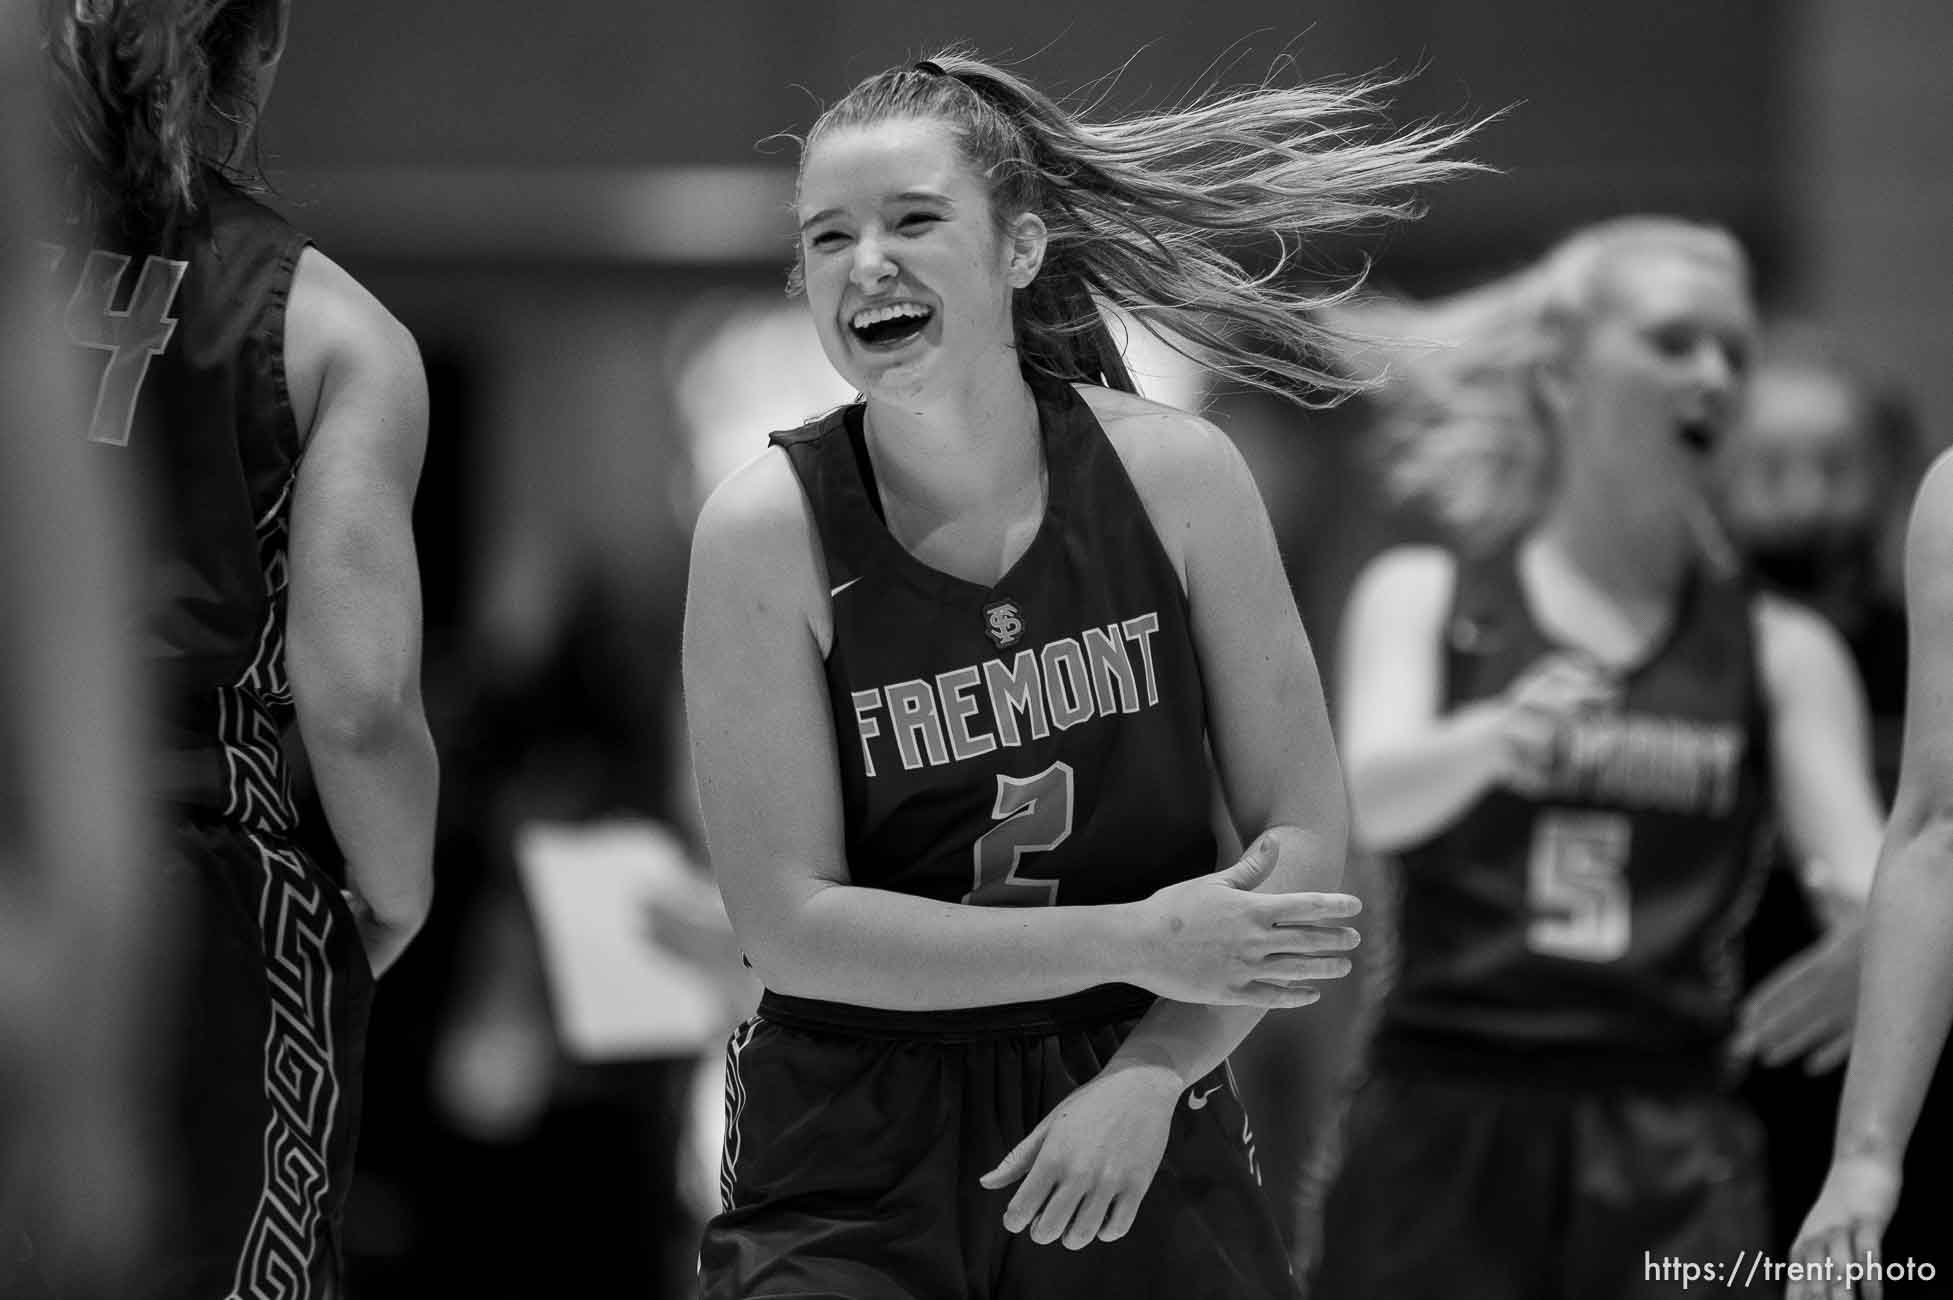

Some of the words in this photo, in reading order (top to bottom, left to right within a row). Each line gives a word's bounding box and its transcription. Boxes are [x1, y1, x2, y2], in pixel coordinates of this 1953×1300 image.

[38, 242, 190, 447] 4
[851, 612, 1159, 777] FREMONT
[962, 760, 1074, 906] 2
[1526, 809, 1632, 963] 5
